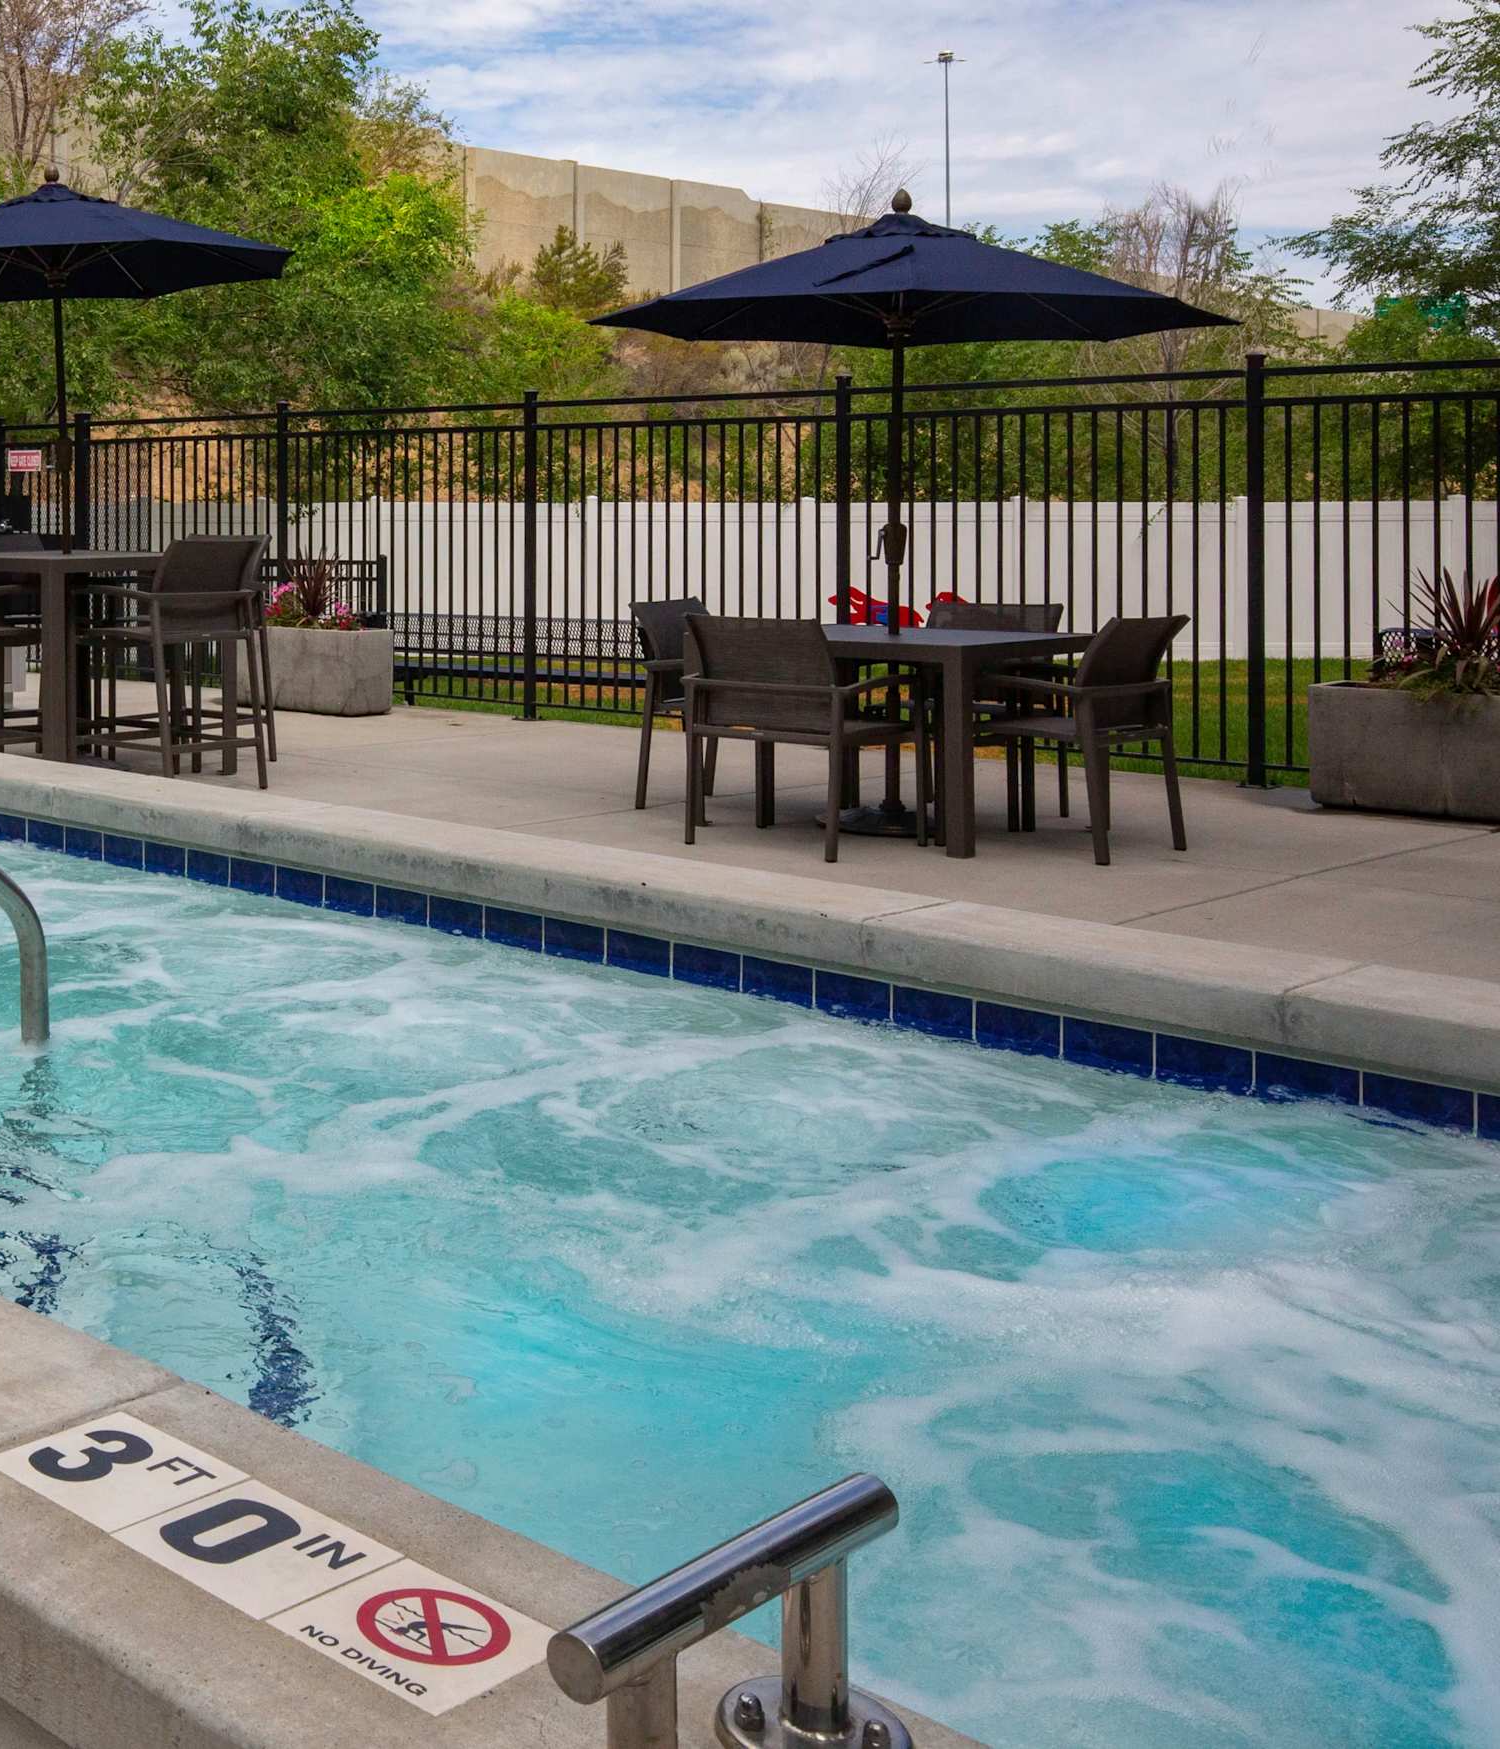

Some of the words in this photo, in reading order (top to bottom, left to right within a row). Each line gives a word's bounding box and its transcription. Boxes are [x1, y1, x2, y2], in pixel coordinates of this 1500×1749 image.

[28, 1430, 153, 1482] 3
[146, 1456, 217, 1486] FT
[159, 1498, 302, 1564] 0
[292, 1533, 366, 1570] IN
[299, 1624, 340, 1647] NO
[340, 1647, 428, 1697] DIVING
